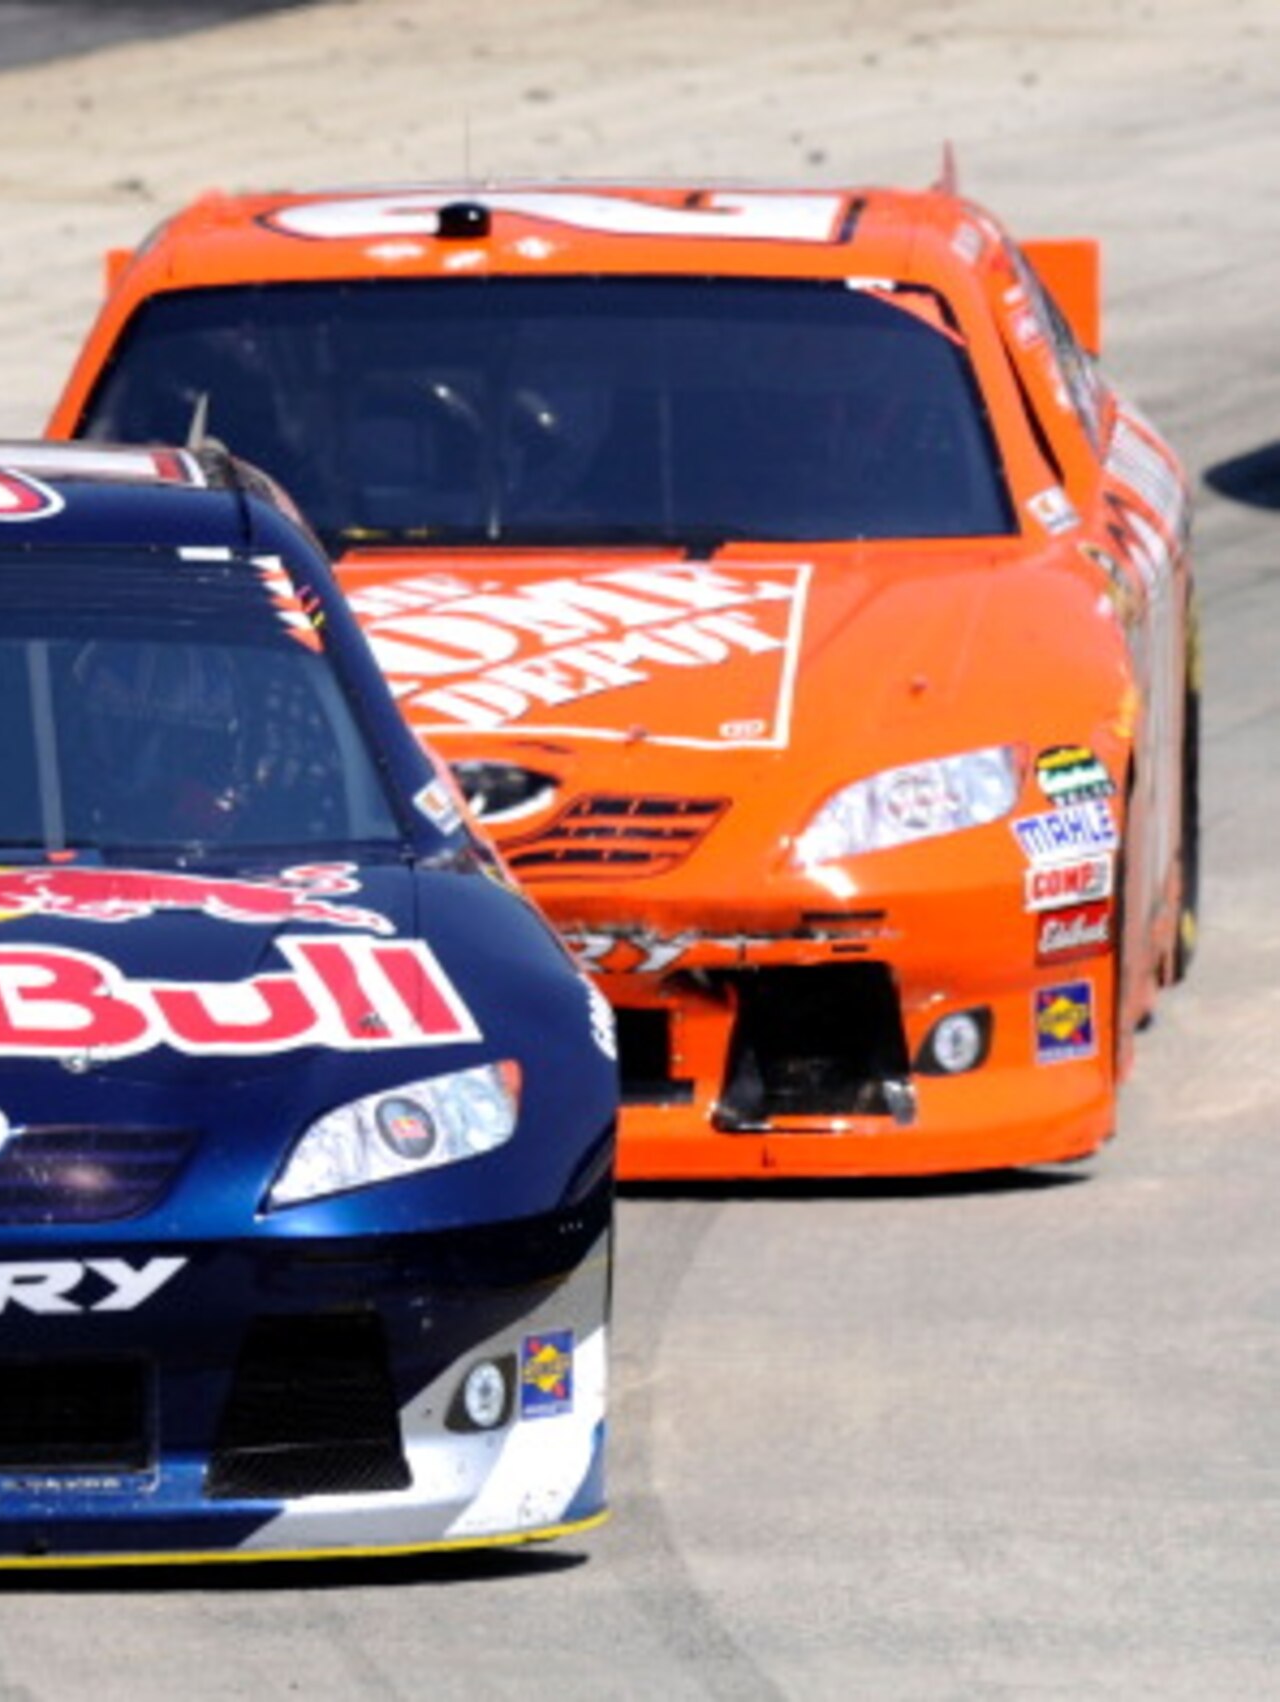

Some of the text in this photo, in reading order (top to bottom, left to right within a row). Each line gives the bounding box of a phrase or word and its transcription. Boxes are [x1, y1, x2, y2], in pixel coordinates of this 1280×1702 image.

[365, 562, 796, 700] OME
[408, 611, 788, 728] DEPOT
[1016, 800, 1115, 854] MAHLE
[1033, 861, 1094, 900] COMP
